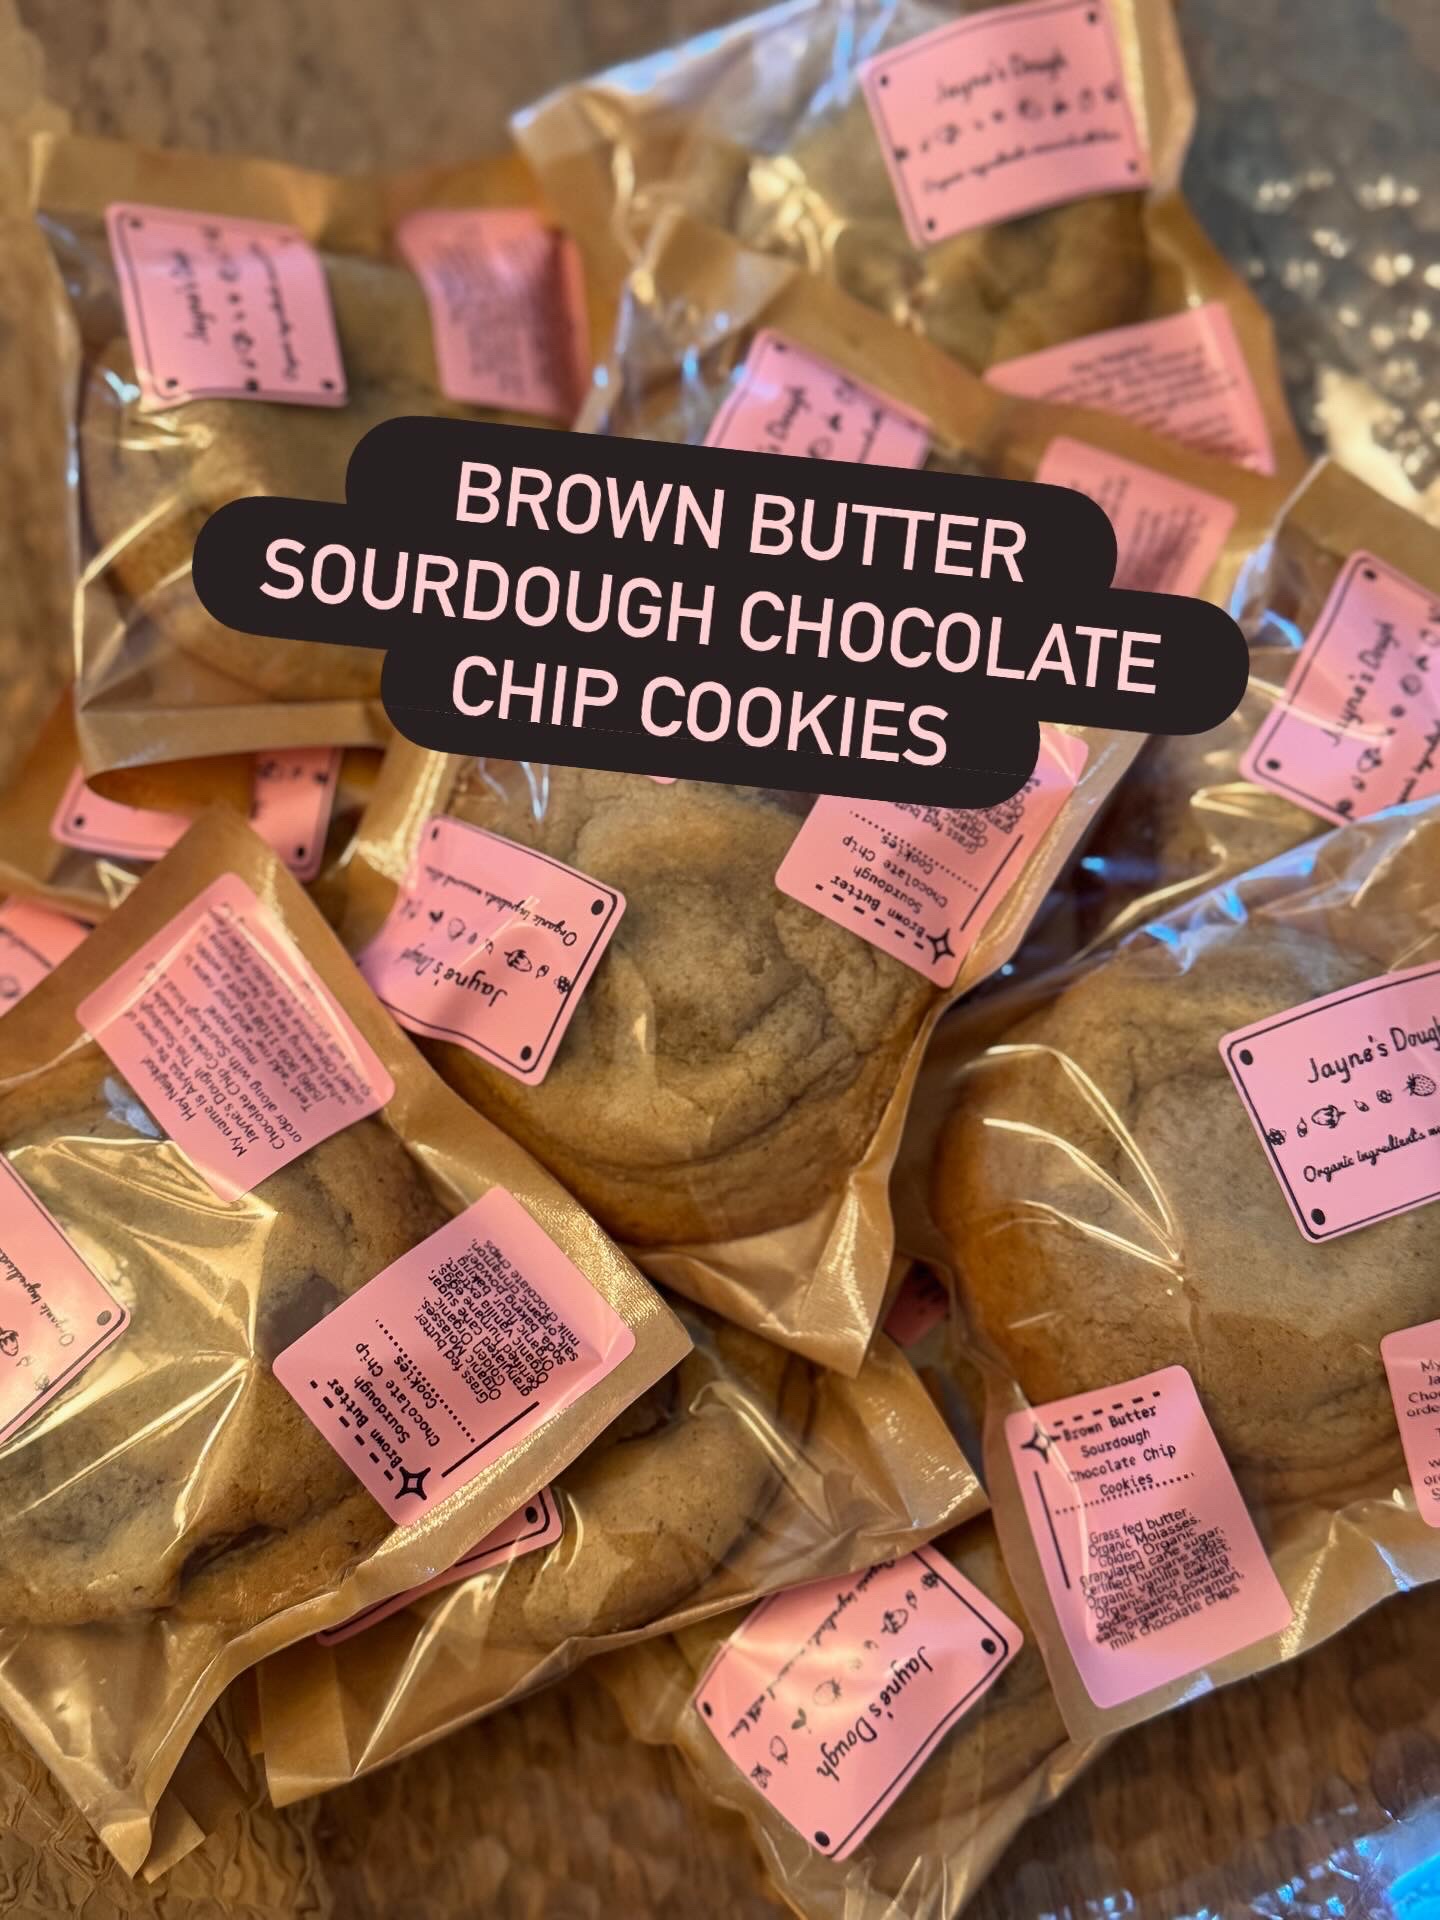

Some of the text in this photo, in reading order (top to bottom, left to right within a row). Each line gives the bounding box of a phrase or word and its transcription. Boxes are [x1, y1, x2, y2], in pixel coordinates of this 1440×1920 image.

[842, 835, 948, 909] Chocolate Chip
[880, 835, 933, 875] Cookies
[830, 875, 926, 939] Brown Butter
[853, 865, 923, 914] Sourdough
[532, 914, 577, 947] Organic
[433, 961, 508, 1007] Jayne's
[228, 1056, 251, 1081] with
[1307, 1035, 1389, 1084] Jayne's
[217, 1068, 241, 1096] Chip
[249, 1080, 278, 1112] along
[289, 1085, 313, 1113] Text
[175, 1096, 197, 1122] Hey
[204, 1105, 233, 1137] name
[224, 1103, 260, 1144] Jayne's
[239, 1094, 285, 1150] Chocolate
[274, 1114, 302, 1143] order
[230, 1136, 248, 1157] My
[1303, 1155, 1355, 1183] Organic
[457, 1256, 492, 1296] baking
[510, 1270, 558, 1322] chocolate
[457, 1307, 483, 1336] cane
[463, 1296, 505, 1346] humane
[480, 1299, 513, 1338] vanilla
[504, 1294, 540, 1334] baking
[518, 1292, 557, 1336] organic
[434, 1297, 506, 1387] Golden Organic
[516, 1324, 554, 1370] Organic
[554, 1322, 580, 1347] milk
[442, 1349, 464, 1372] fed
[464, 1354, 502, 1401] Organic
[479, 1336, 535, 1397] granulated
[508, 1336, 549, 1384] Organic
[355, 1343, 440, 1447] Chocolate Chip
[393, 1355, 437, 1409] Cookies
[461, 1368, 490, 1404] Grass
[327, 1378, 403, 1469] Brown Butter
[354, 1375, 411, 1444] Sourdough
[1062, 1405, 1156, 1442] Brown Butter
[1080, 1427, 1151, 1458] Sourdough
[1067, 1444, 1176, 1482] Chocolate Chip
[1099, 1473, 1154, 1497] Cookies
[1088, 1528, 1121, 1546] Grass
[1122, 1520, 1144, 1536] fed
[1088, 1534, 1132, 1559] Organic
[1098, 1527, 1196, 1568] Golden Organic
[1148, 1547, 1180, 1567] cane
[1109, 1630, 1138, 1651] milk
[1139, 1600, 1203, 1637] chocolate
[816, 1646, 933, 1782] Jayne's Dough
